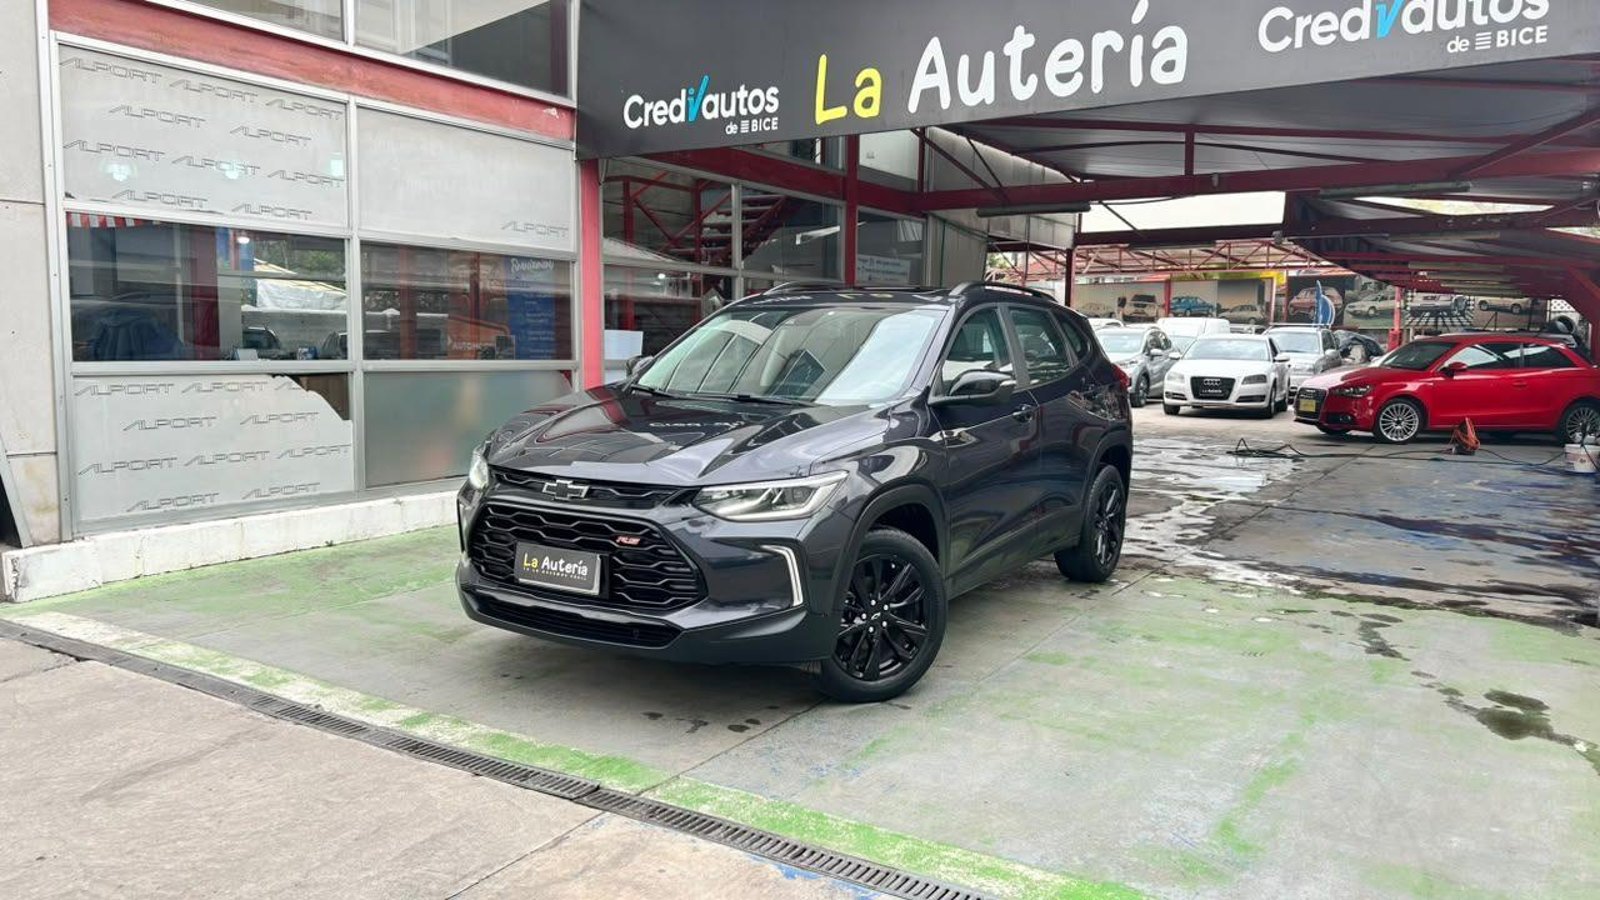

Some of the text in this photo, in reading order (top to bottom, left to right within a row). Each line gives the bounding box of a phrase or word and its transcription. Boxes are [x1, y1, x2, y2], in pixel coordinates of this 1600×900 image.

[1446, 25, 1548, 53] de BICE
[815, 0, 1188, 125] La Autería
[59, 57, 343, 120] ALPORT ALPORT ALPORT
[109, 104, 311, 146] ALPORT ALPORT
[725, 117, 778, 135] de BICE
[63, 140, 165, 162] ALPORT
[74, 383, 174, 396] ALPORT
[123, 411, 319, 431] ALPORT ALPORT
[78, 457, 177, 475] ALPORT
[184, 450, 270, 466] ALPORT
[241, 482, 320, 500] ALPORT
[523, 552, 538, 568] La
[541, 556, 588, 576] Autería
